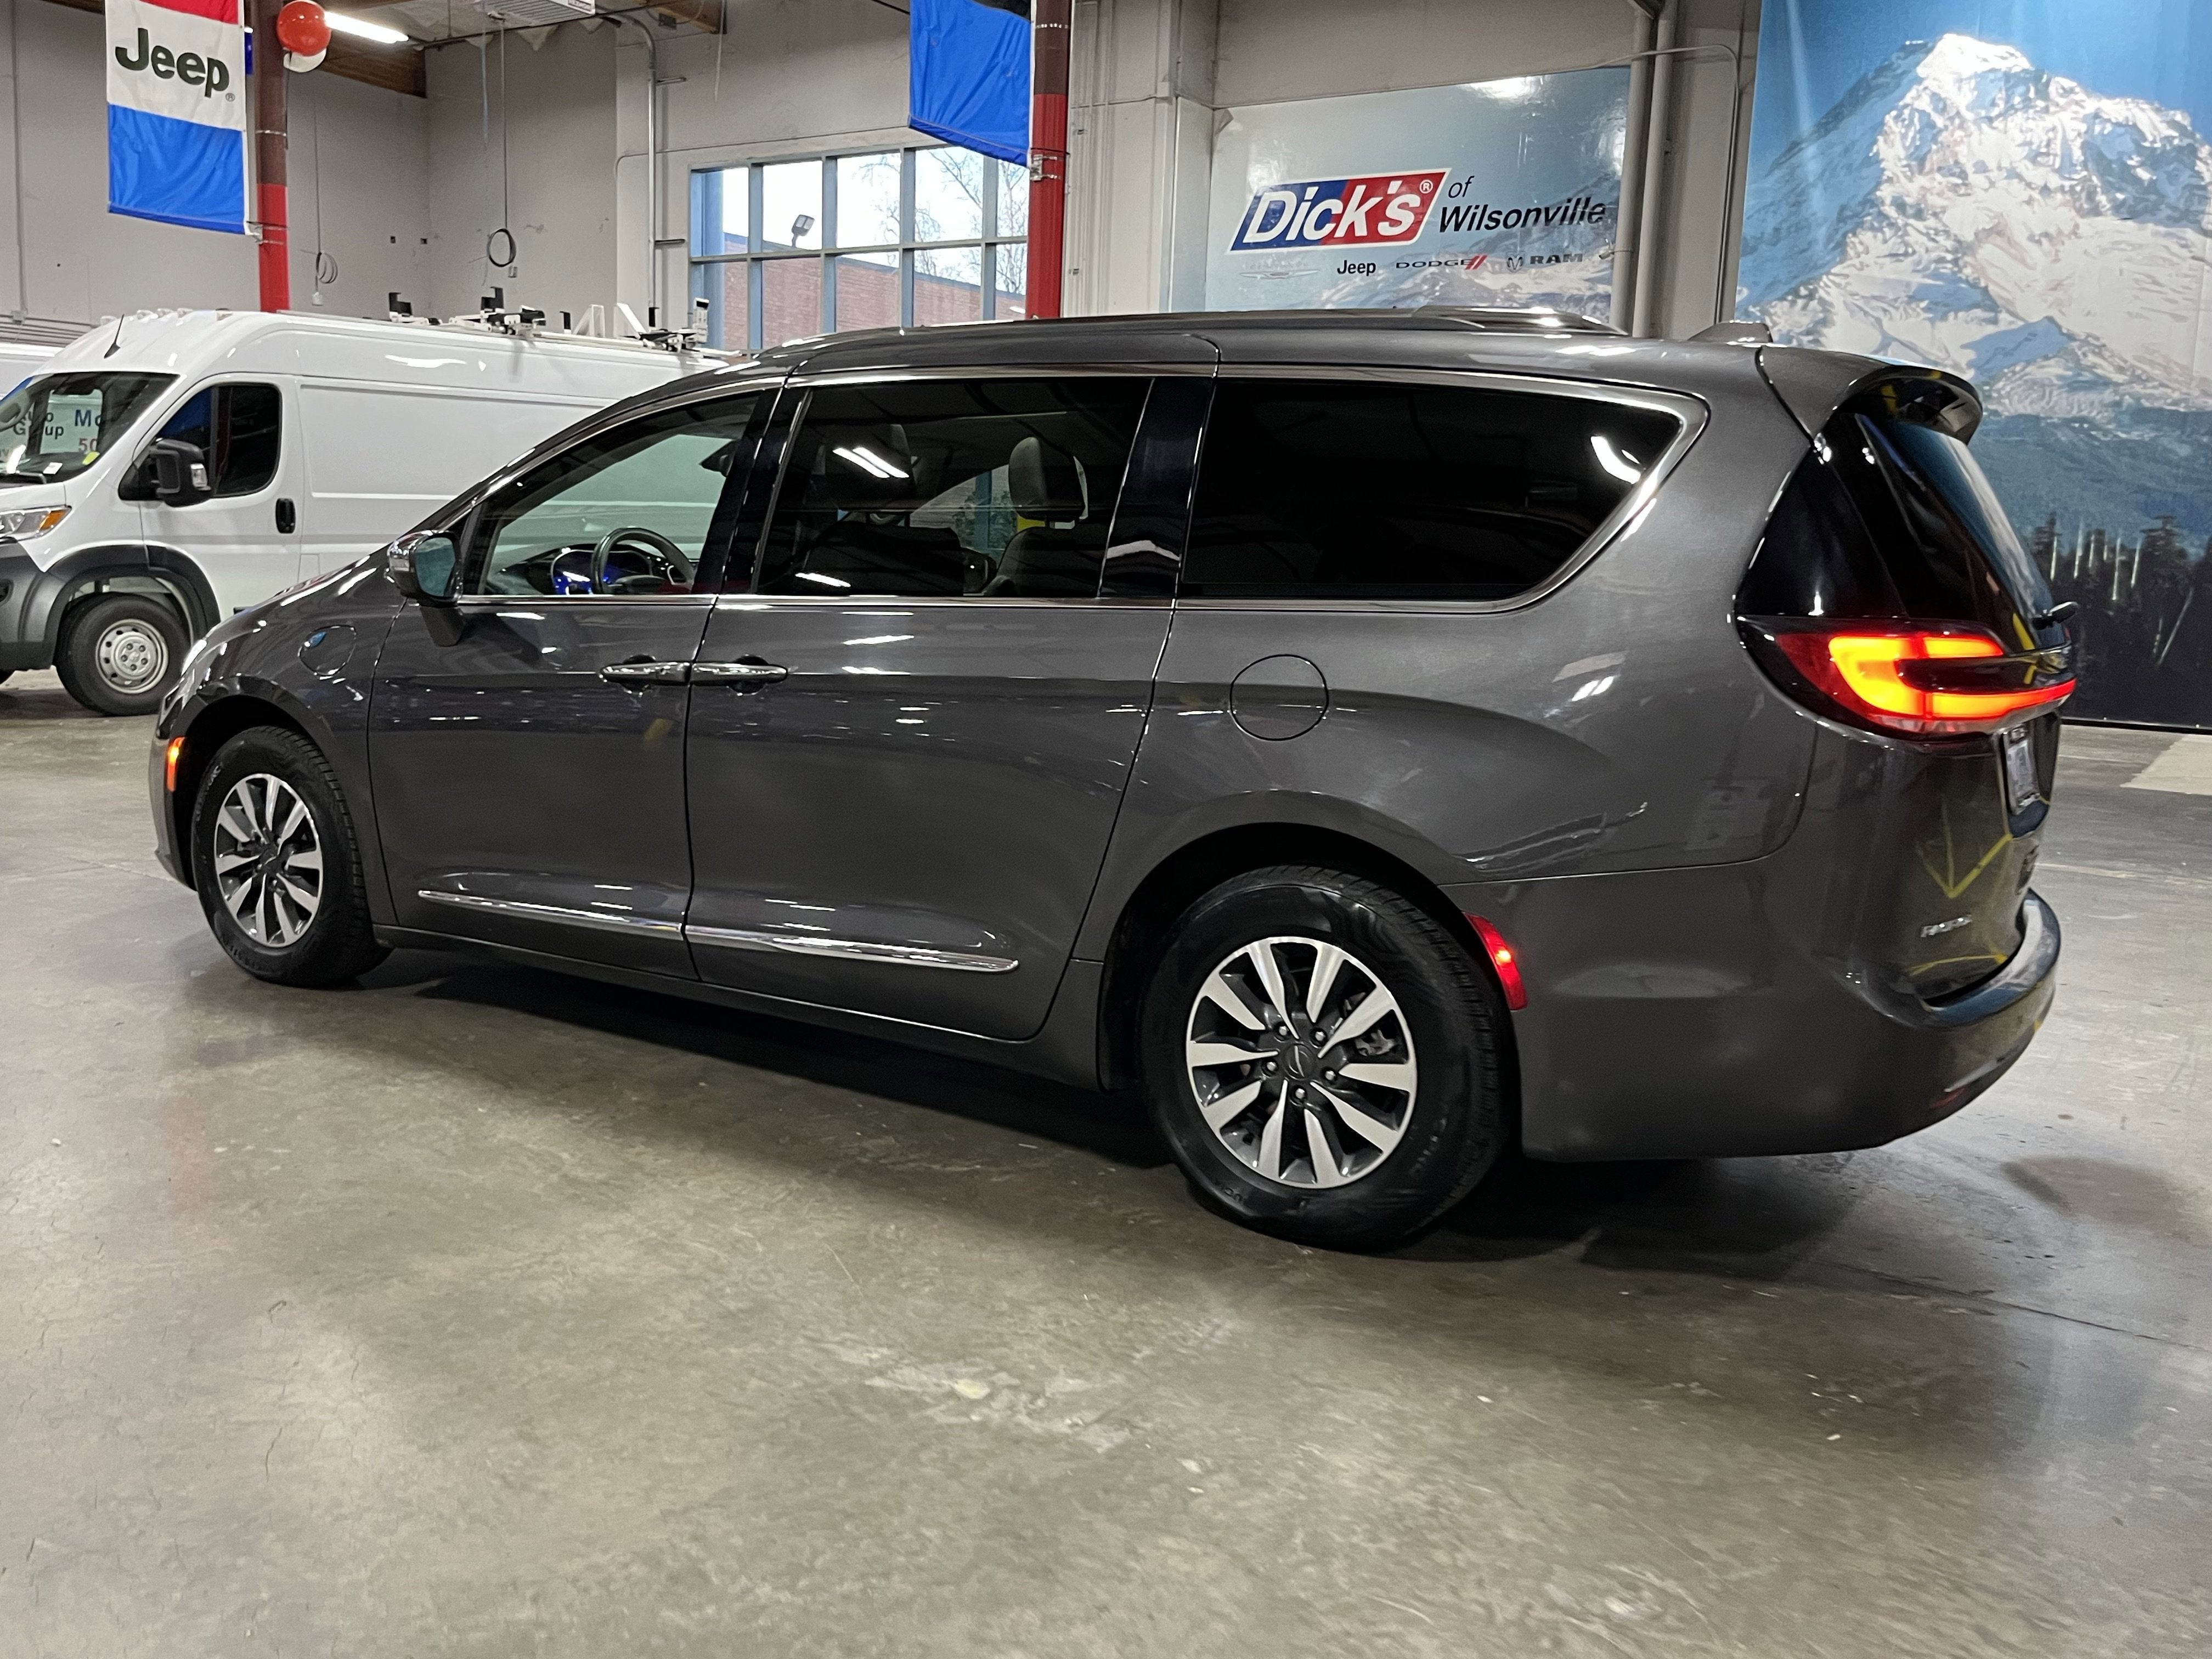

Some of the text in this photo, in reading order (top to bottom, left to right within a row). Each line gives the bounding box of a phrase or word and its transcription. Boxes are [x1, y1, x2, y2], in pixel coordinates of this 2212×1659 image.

[115, 27, 229, 98] Jeep
[1448, 176, 1475, 198] of
[1242, 180, 1421, 243] Dick's
[1439, 197, 1606, 233] Wilsonville
[1337, 253, 1583, 276] Jeep DODGE RAM
